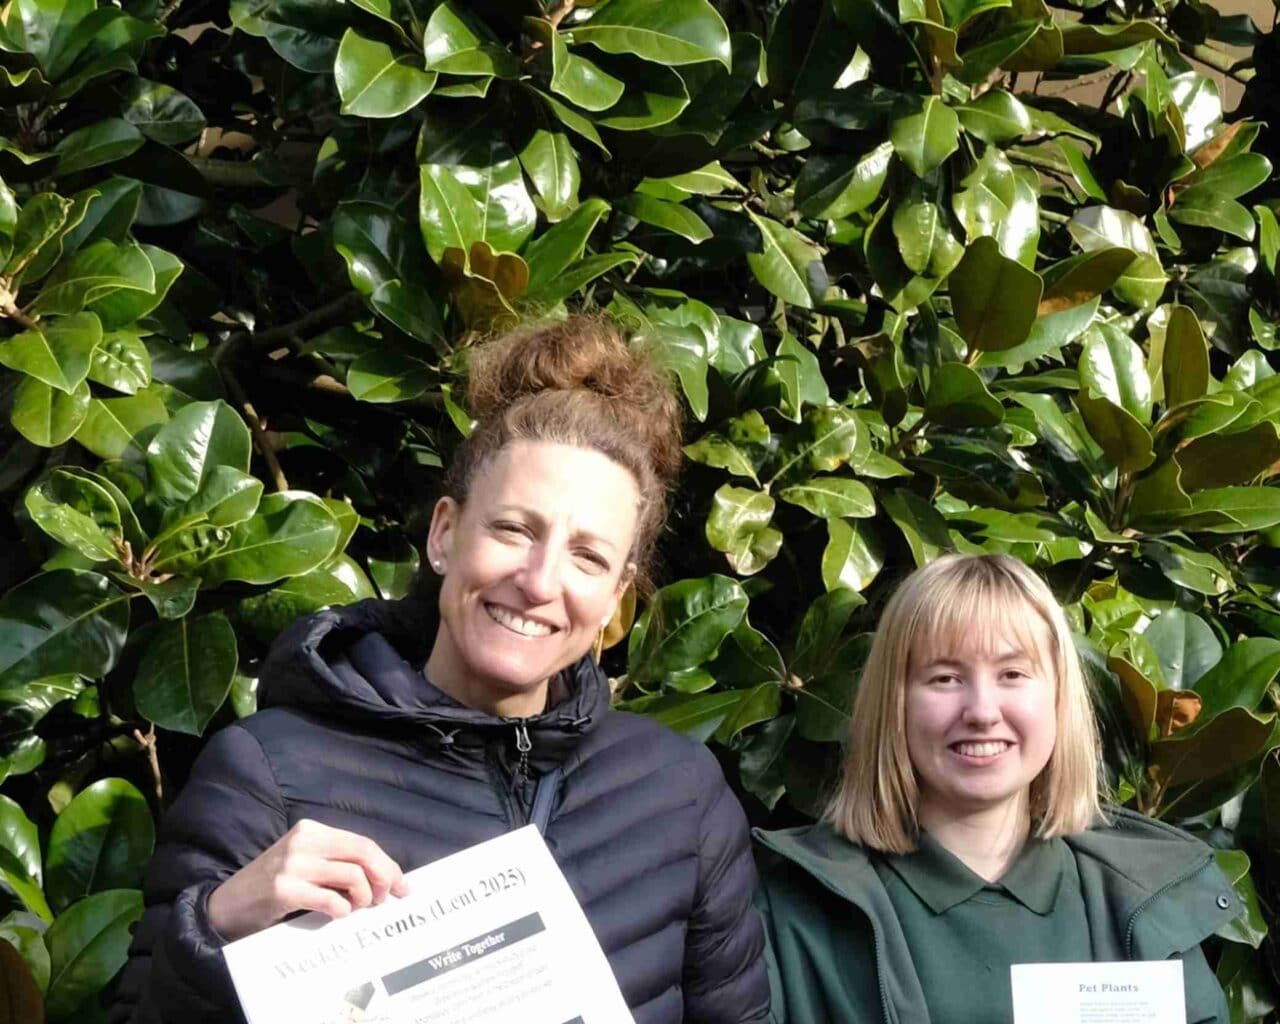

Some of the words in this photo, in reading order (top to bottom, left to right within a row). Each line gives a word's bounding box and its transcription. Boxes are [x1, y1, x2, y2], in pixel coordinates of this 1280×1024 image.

[355, 912, 427, 949] Events
[429, 889, 478, 920] (Lent
[478, 867, 527, 898] 2025)
[429, 949, 463, 970] Write
[462, 932, 506, 958] Together
[1078, 983, 1096, 992] Pet
[1101, 983, 1138, 992] Plants
